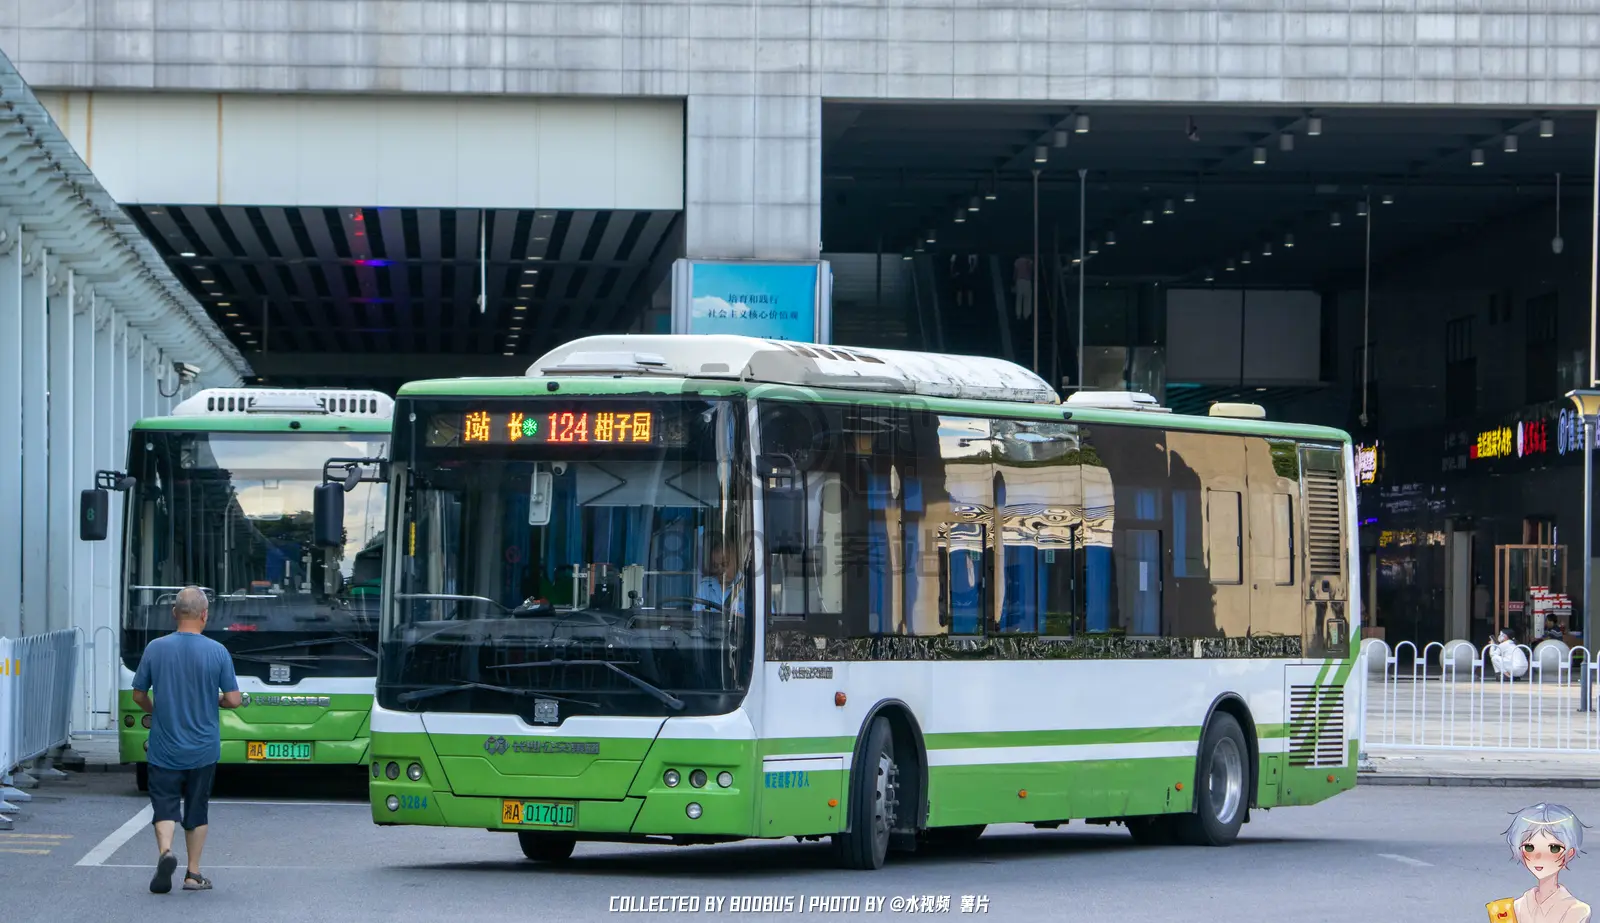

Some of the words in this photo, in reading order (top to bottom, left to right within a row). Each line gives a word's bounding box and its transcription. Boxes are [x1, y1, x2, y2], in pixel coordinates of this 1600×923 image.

[728, 293, 779, 304] 培育和践行
[708, 308, 799, 320] 社会主义核心价值观
[547, 412, 588, 442] 124
[594, 412, 651, 442] 柑子园
[268, 744, 310, 757] 01811D
[400, 794, 428, 809] 3284
[526, 804, 574, 823] 01701D
